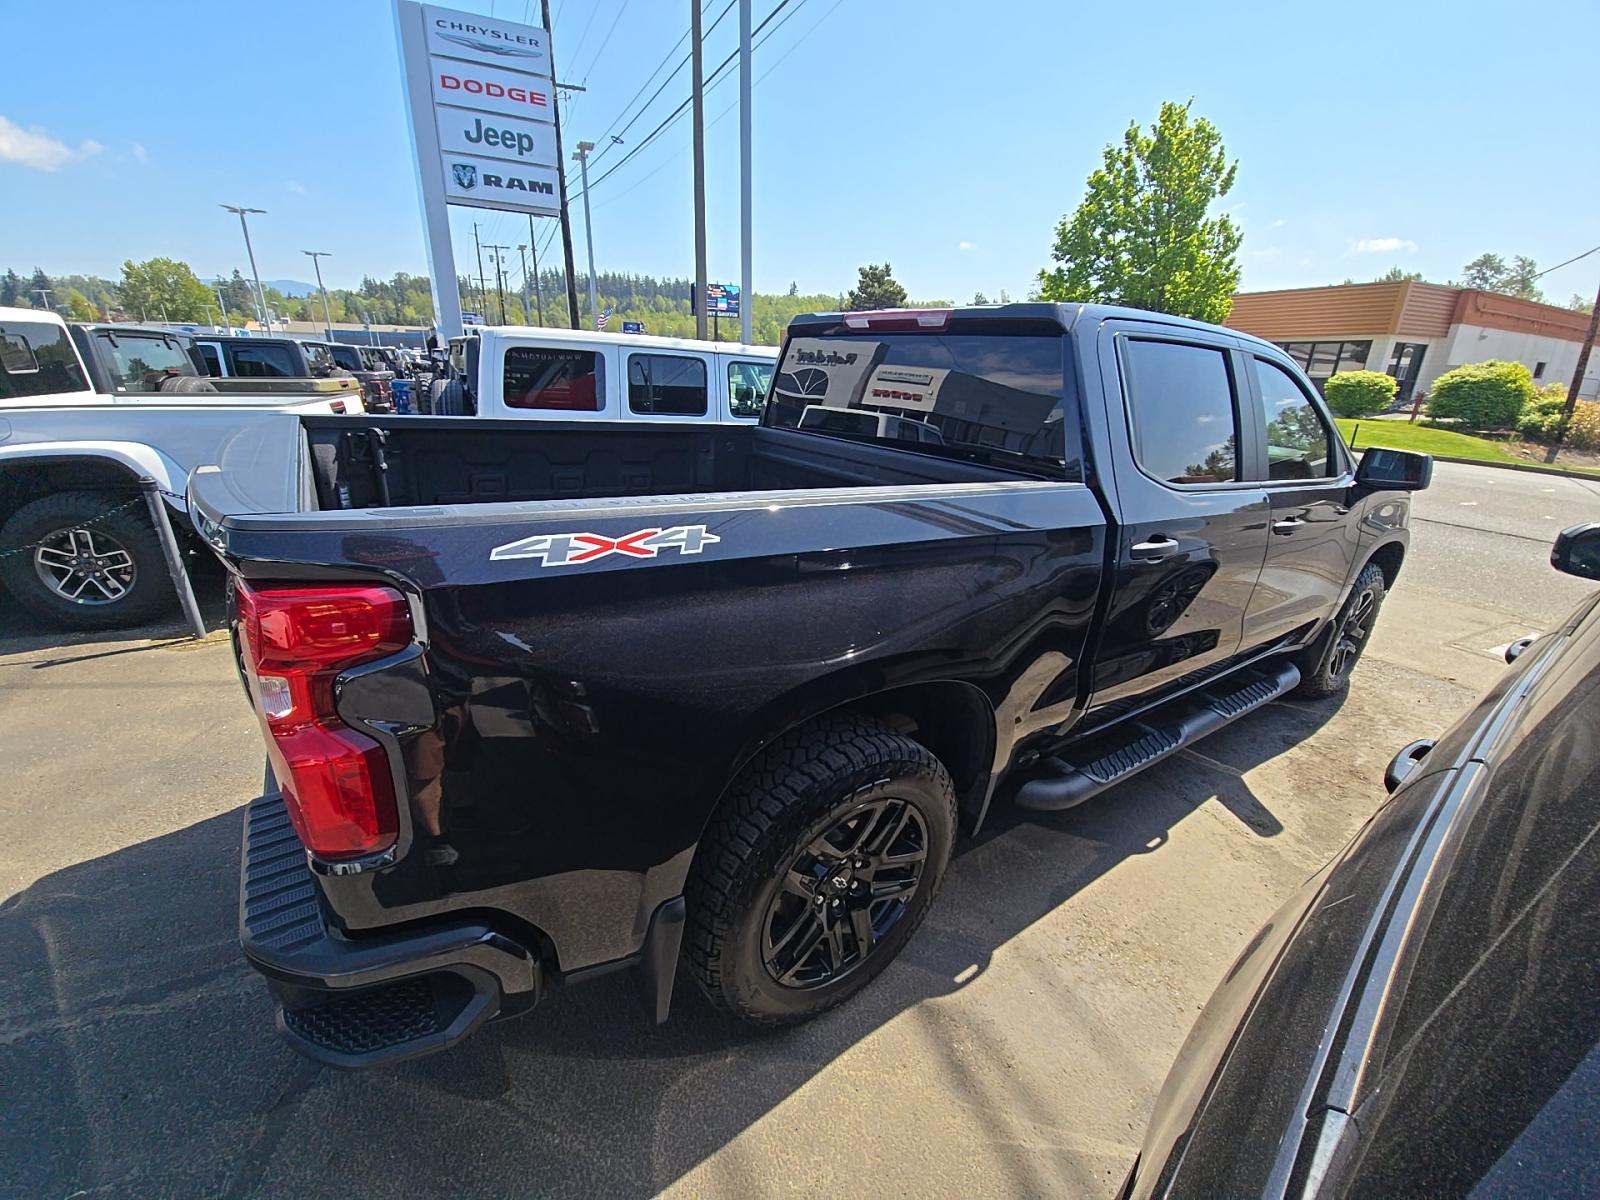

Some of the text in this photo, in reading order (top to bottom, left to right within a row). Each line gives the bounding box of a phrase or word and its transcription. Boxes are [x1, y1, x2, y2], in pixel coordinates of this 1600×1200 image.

[436, 19, 540, 48] CHRYSLER
[440, 74, 547, 106] DODGE
[464, 118, 534, 156] Jeep
[483, 173, 553, 195] RAM
